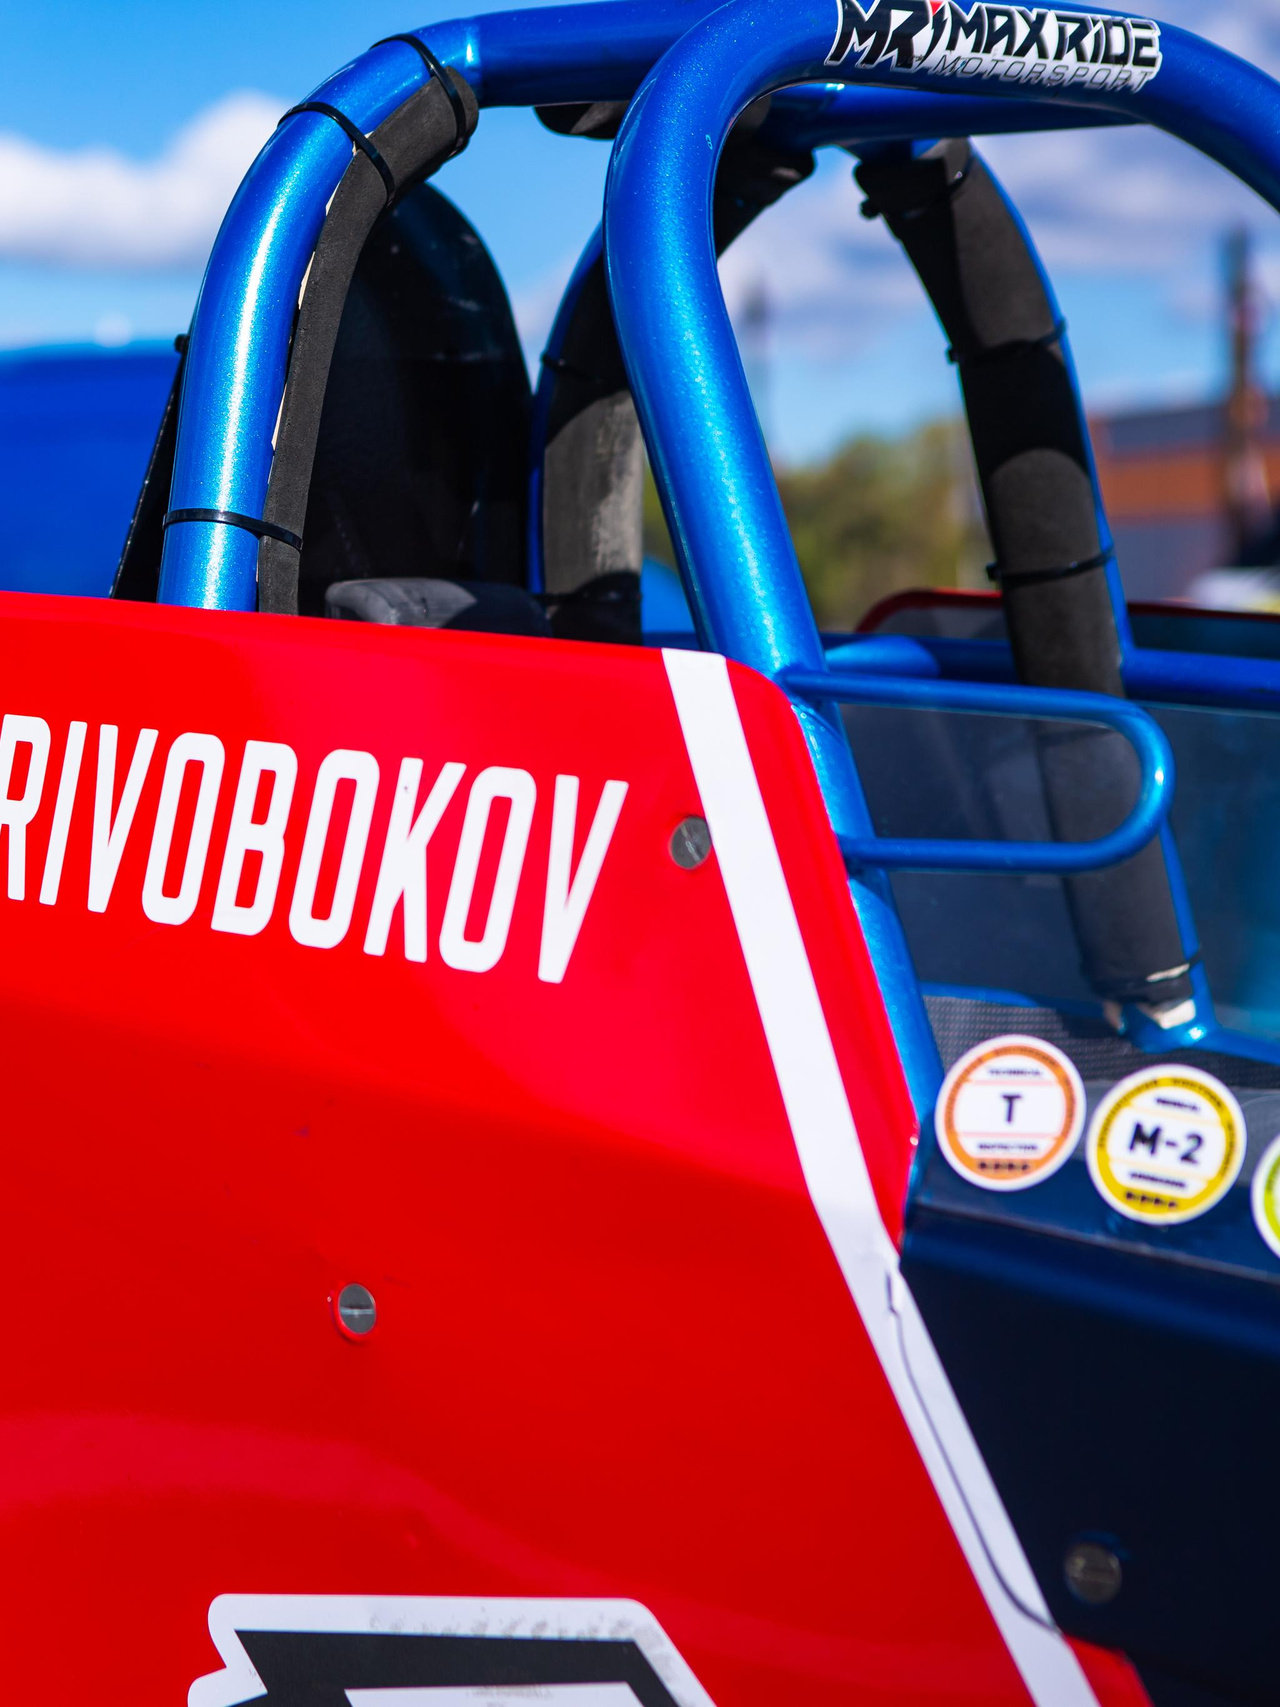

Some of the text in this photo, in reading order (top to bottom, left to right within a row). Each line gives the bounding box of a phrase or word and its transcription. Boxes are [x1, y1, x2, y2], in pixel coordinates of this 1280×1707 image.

[933, 54, 1157, 91] MOTORSPORT
[1001, 1093, 1023, 1124] T
[1129, 1121, 1205, 1164] M-2
